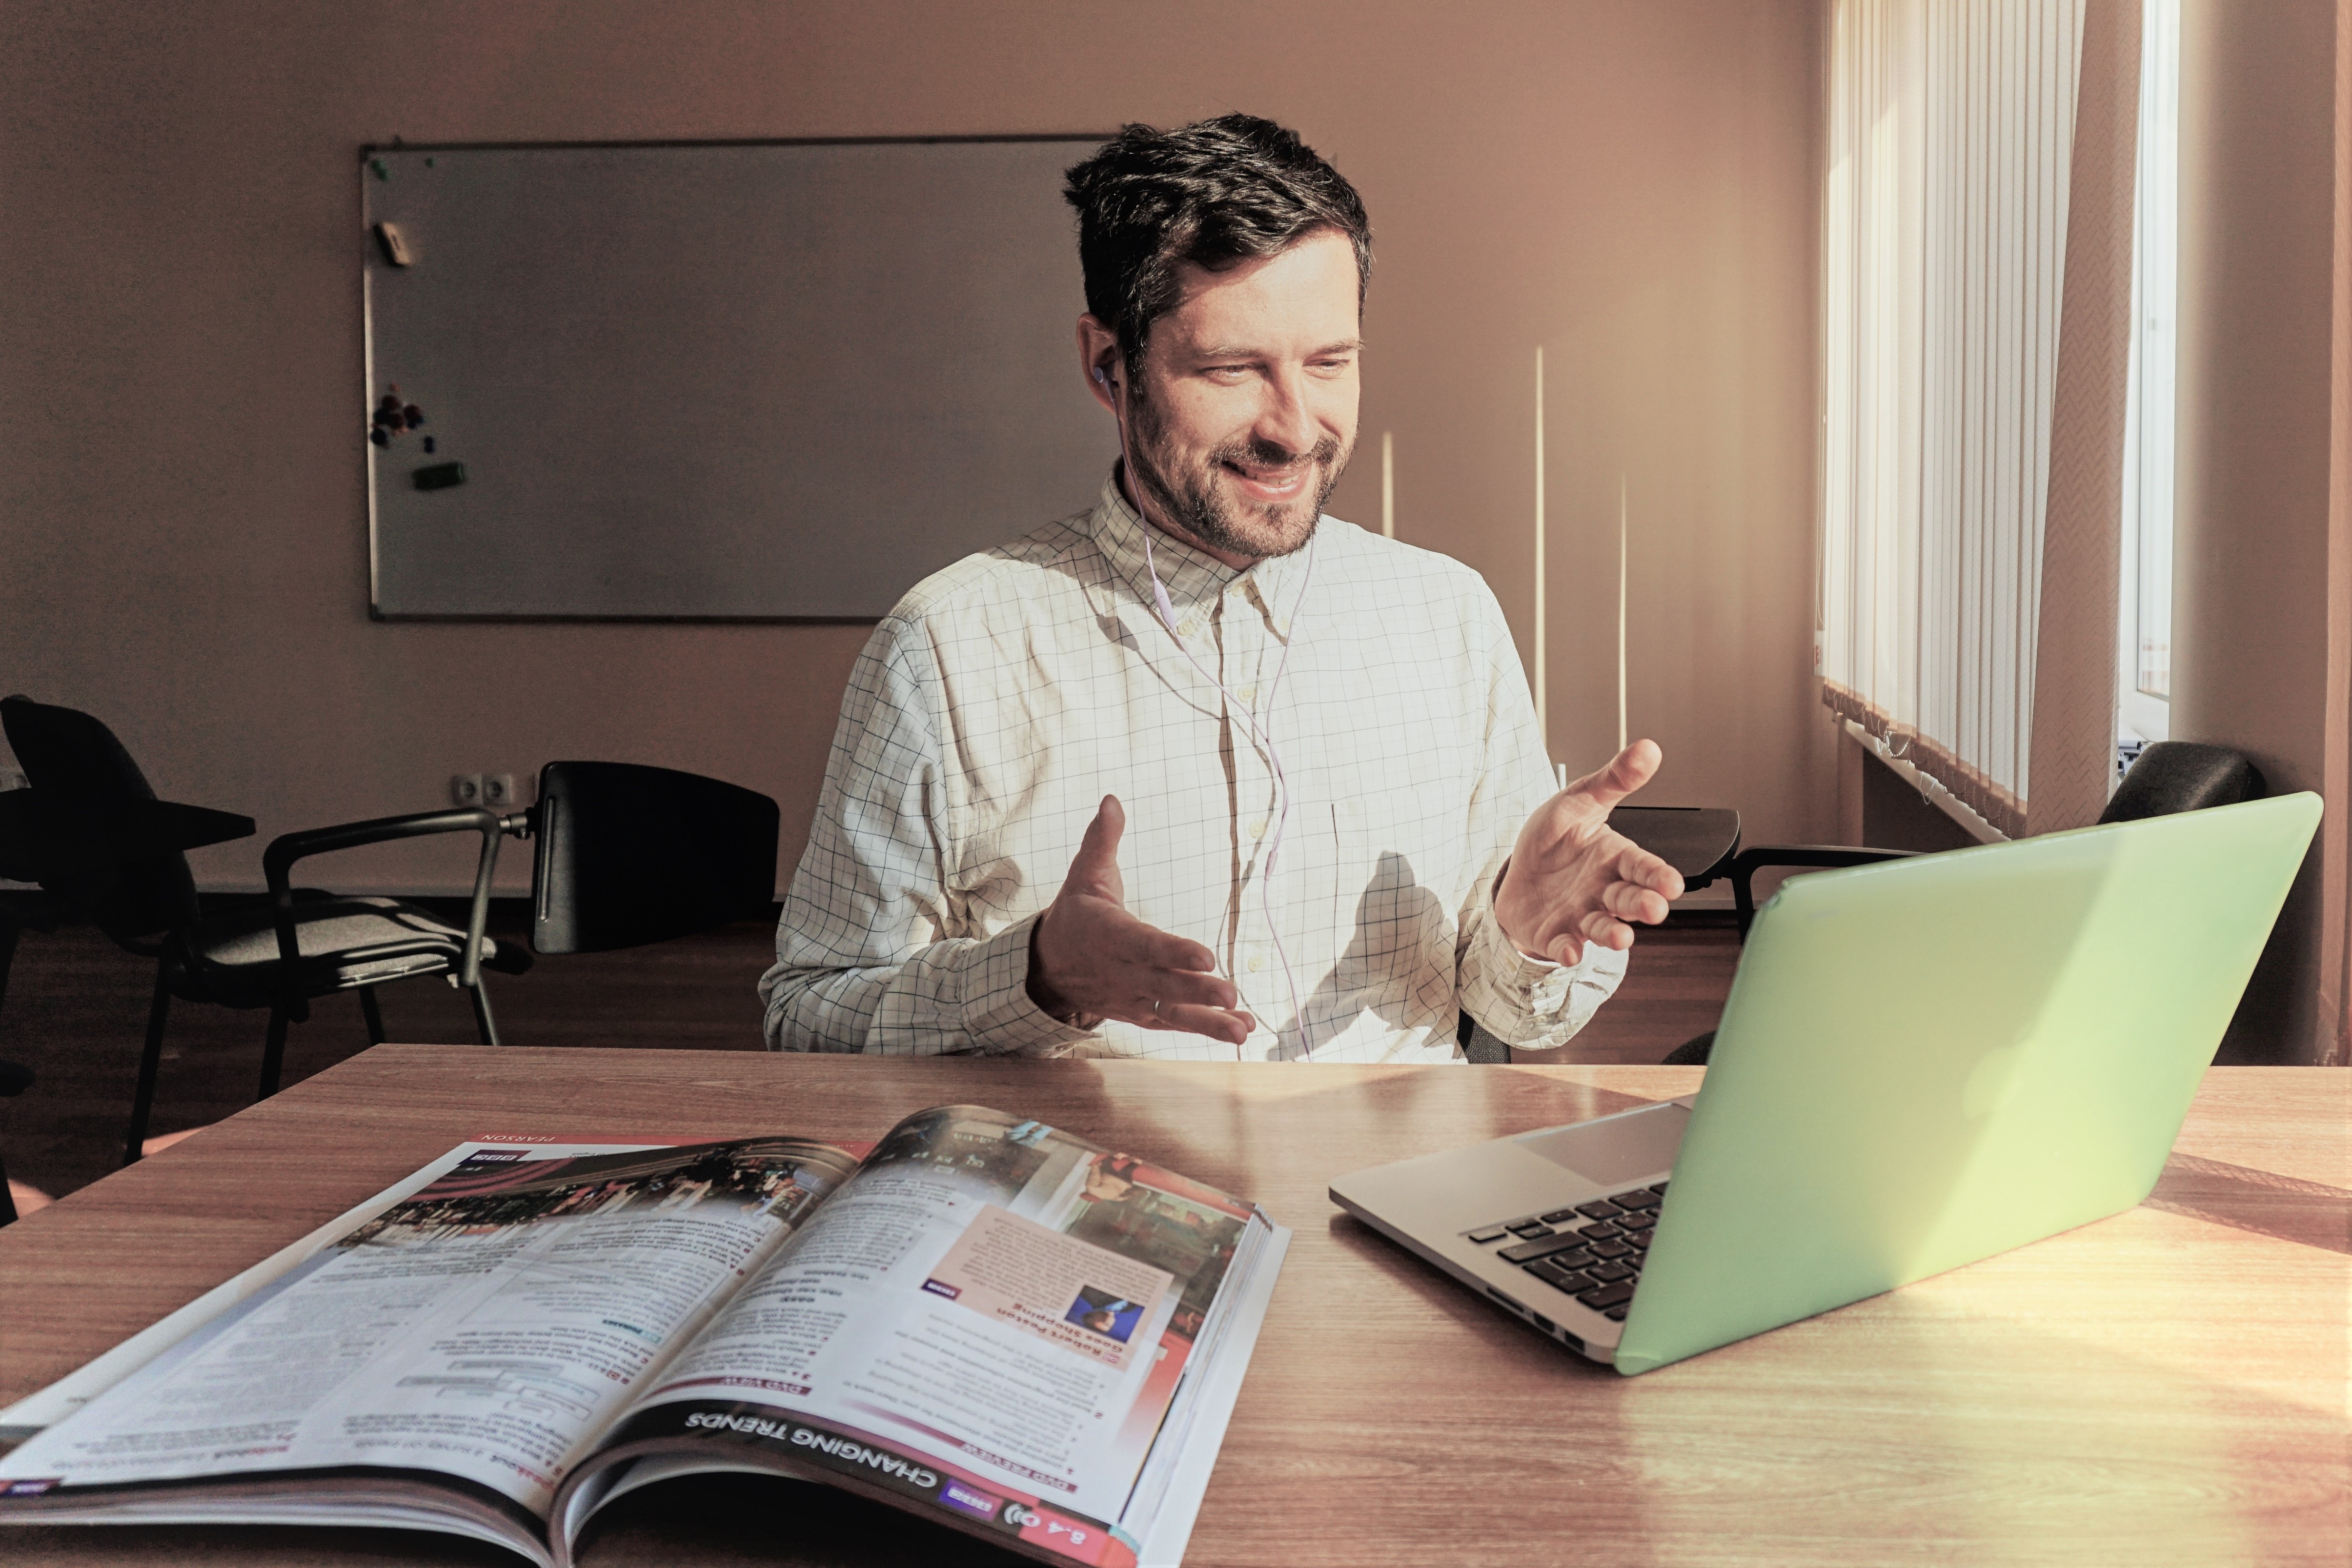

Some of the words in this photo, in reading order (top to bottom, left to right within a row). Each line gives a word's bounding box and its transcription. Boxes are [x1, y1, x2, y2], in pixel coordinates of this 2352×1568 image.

[996, 1307, 1047, 1333] Peston
[1012, 1303, 1082, 1338] Shopping
[1050, 1330, 1102, 1356] Robert
[1086, 1335, 1123, 1353] Goes
[765, 1381, 801, 1394] DVD
[685, 1411, 789, 1441] TRENDS
[790, 1427, 938, 1488] CHANGING
[960, 1443, 1031, 1478] PREVIEW
[1033, 1471, 1069, 1491] DVD
[947, 1487, 993, 1512] BBC
[1047, 1520, 1086, 1545] 8.4
